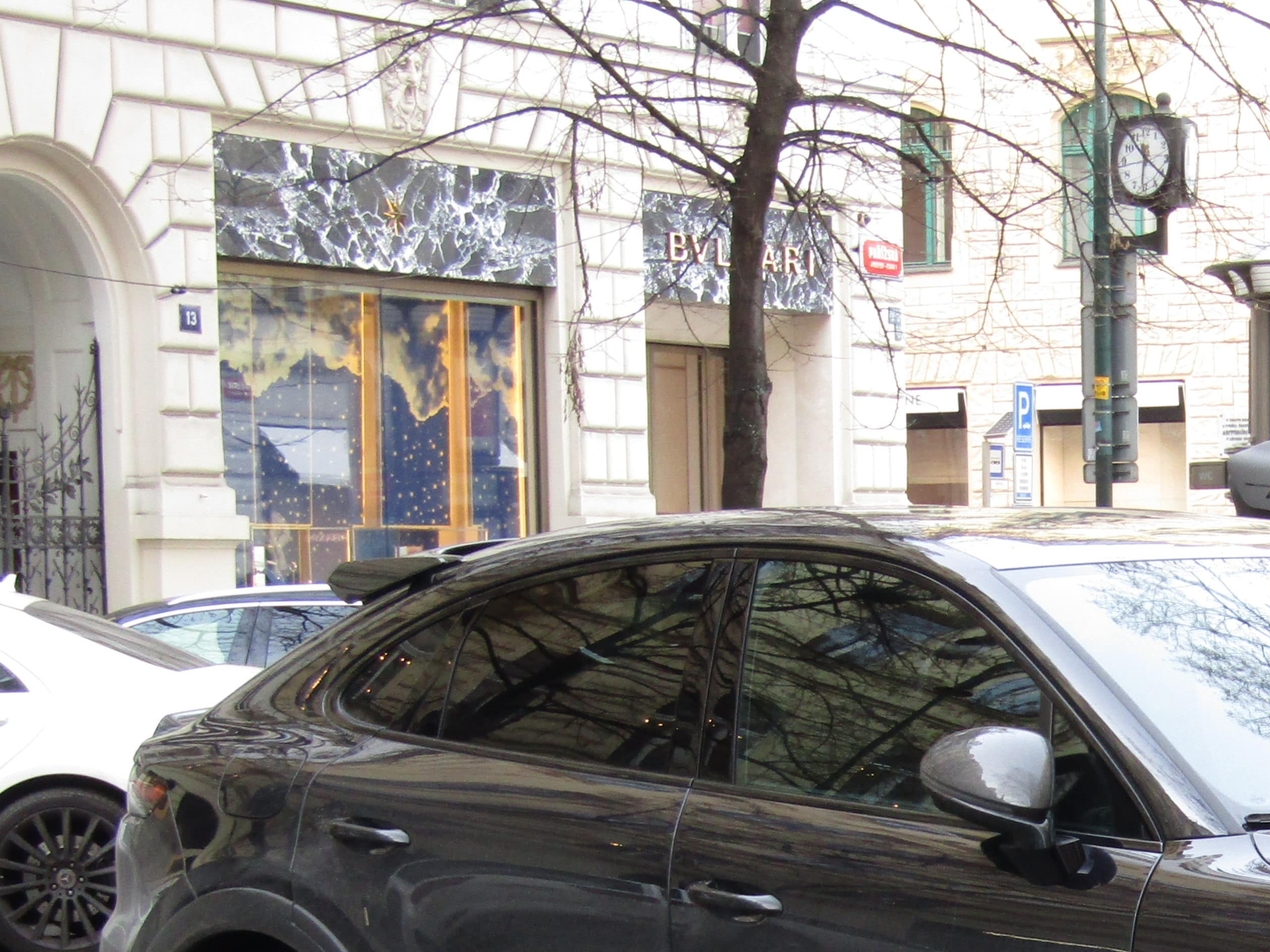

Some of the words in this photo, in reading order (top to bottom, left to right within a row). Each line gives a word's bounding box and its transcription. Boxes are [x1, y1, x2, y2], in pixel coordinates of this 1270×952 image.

[1142, 128, 1150, 137] 12
[668, 232, 815, 277] BVLARI
[186, 311, 198, 326] 13
[1018, 391, 1030, 430] P
